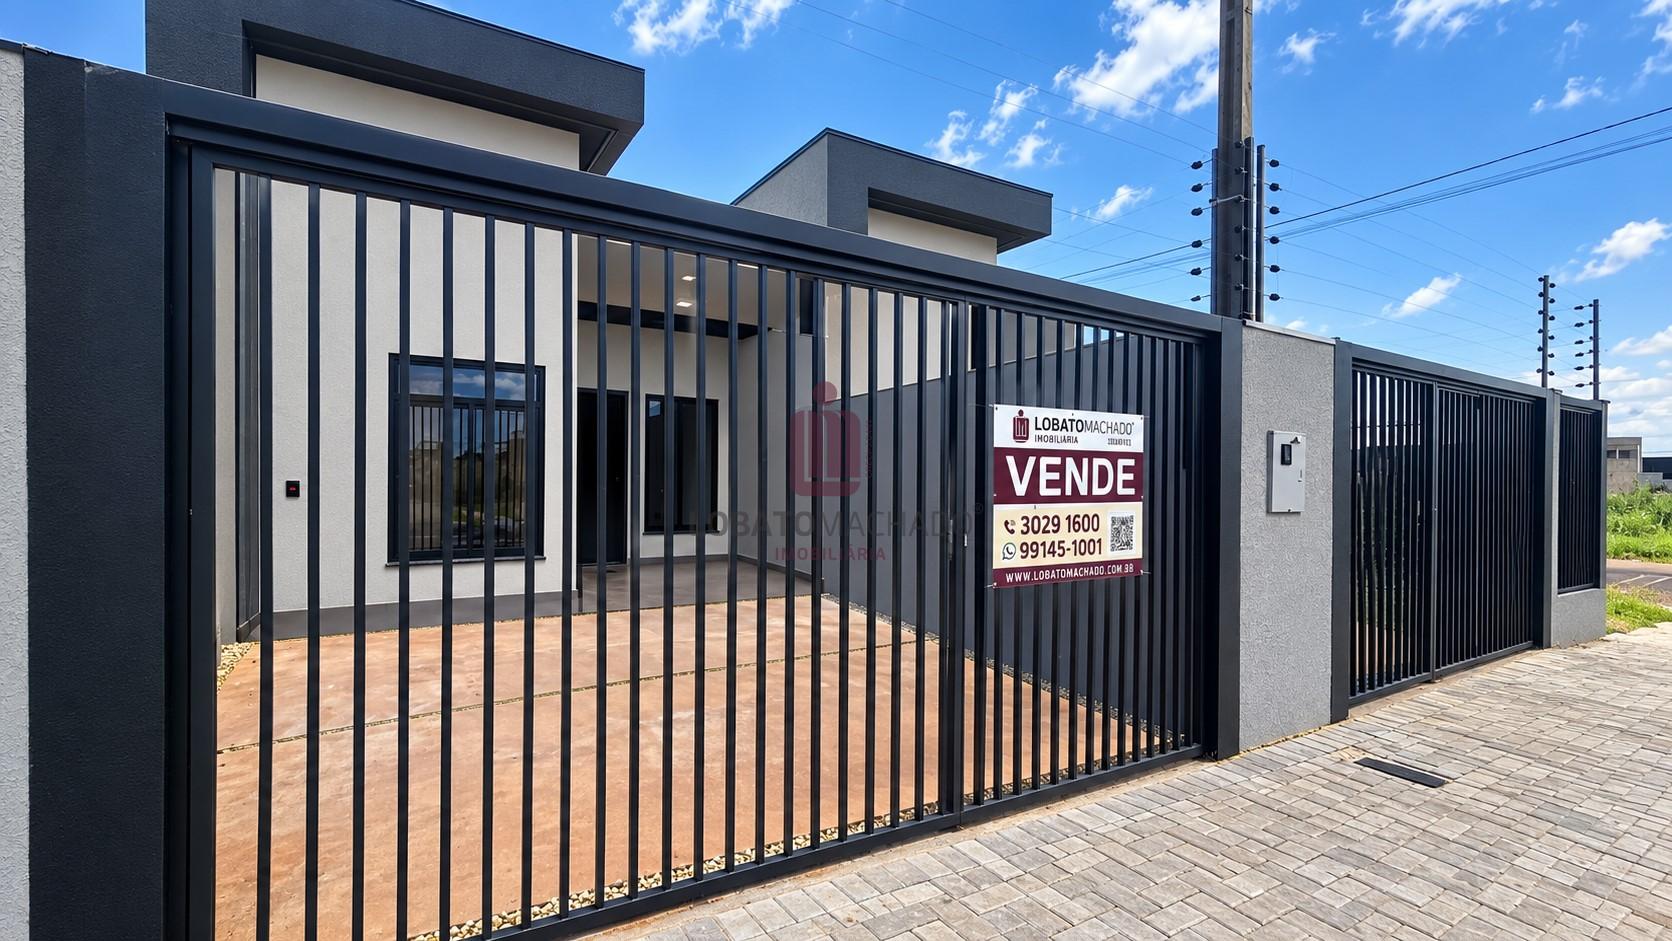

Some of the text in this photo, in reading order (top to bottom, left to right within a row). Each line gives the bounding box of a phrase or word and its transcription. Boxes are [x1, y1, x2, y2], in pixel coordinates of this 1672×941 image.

[1005, 455, 1136, 497] VENDE
[1020, 513, 1100, 535] 3029 1600
[1019, 538, 1102, 559] 99145-1001
